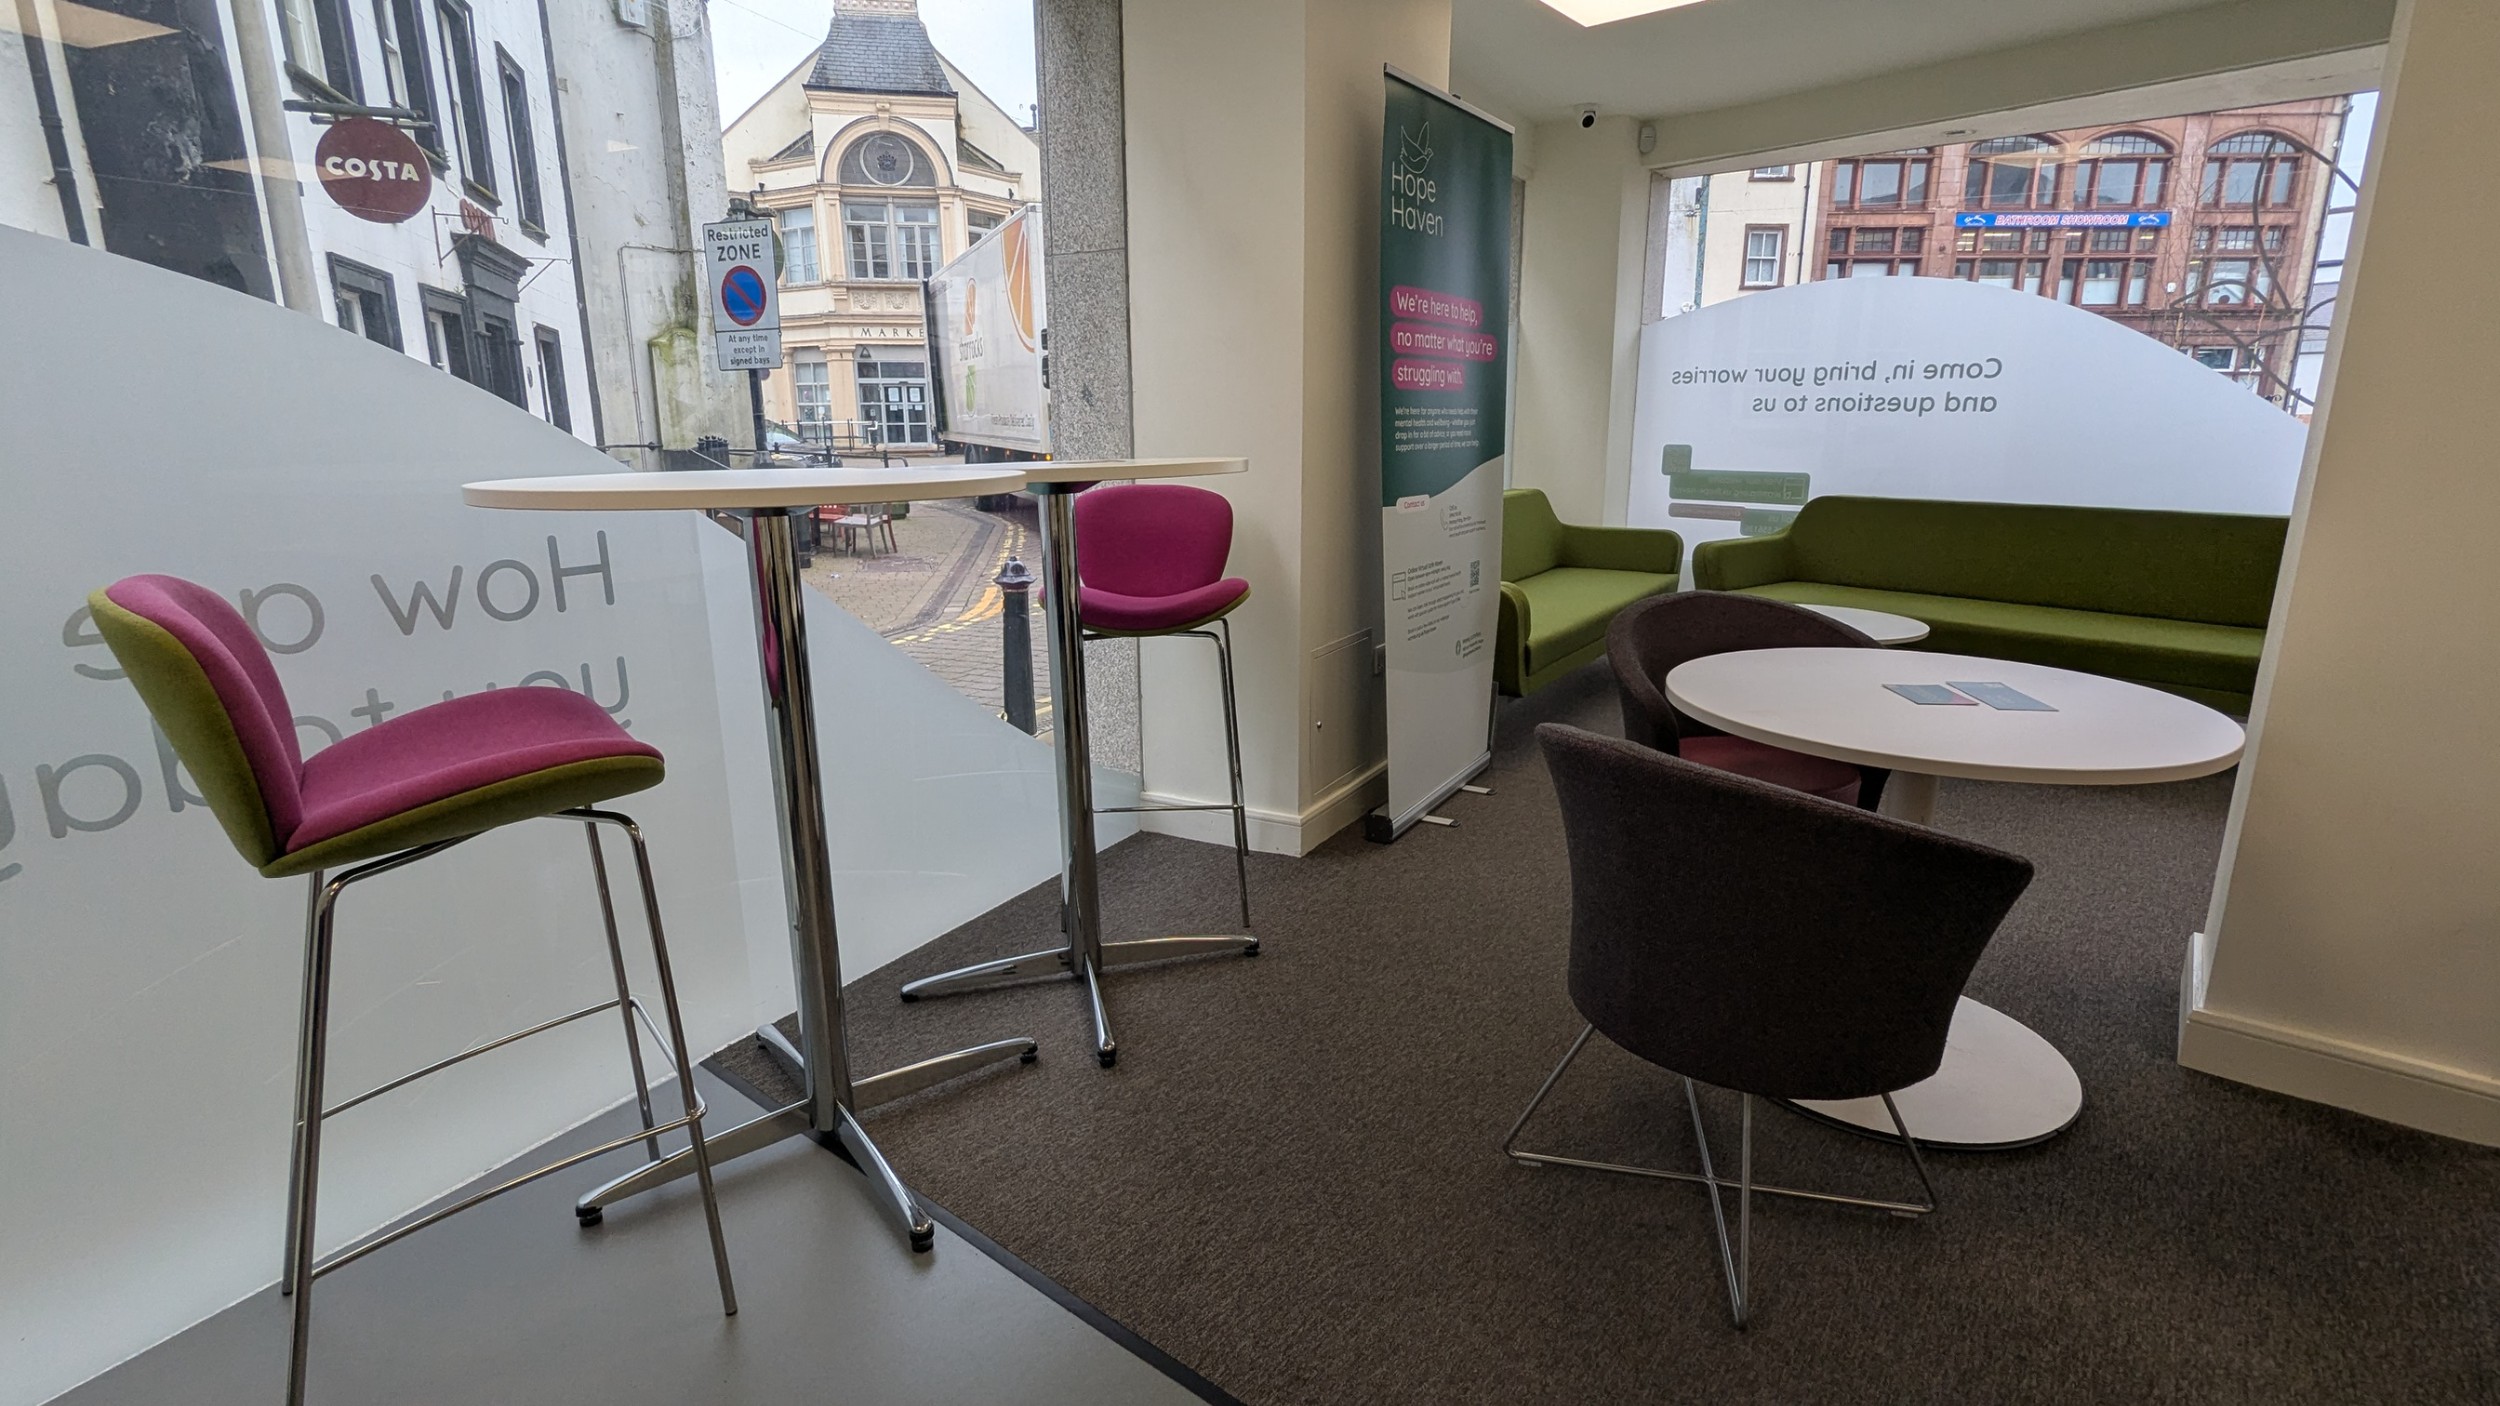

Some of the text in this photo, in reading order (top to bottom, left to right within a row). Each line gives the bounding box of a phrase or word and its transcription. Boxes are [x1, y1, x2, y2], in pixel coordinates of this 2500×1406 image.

[325, 156, 420, 182] COSTA
[1391, 161, 1437, 204] Hope
[1391, 196, 1444, 237] Haven
[1994, 214, 2060, 226] BATHROOM
[2060, 213, 2129, 225] SHOWROOM
[707, 225, 768, 242] Restricted
[716, 243, 761, 262] ZONE
[1396, 291, 1478, 326] We're here to help,
[728, 333, 768, 344] At any time
[860, 327, 924, 337] MARKE
[733, 344, 766, 355] except in
[1397, 330, 1493, 357] no matter what you're
[730, 356, 770, 366] signed bays
[1397, 365, 1463, 387] struggling with.
